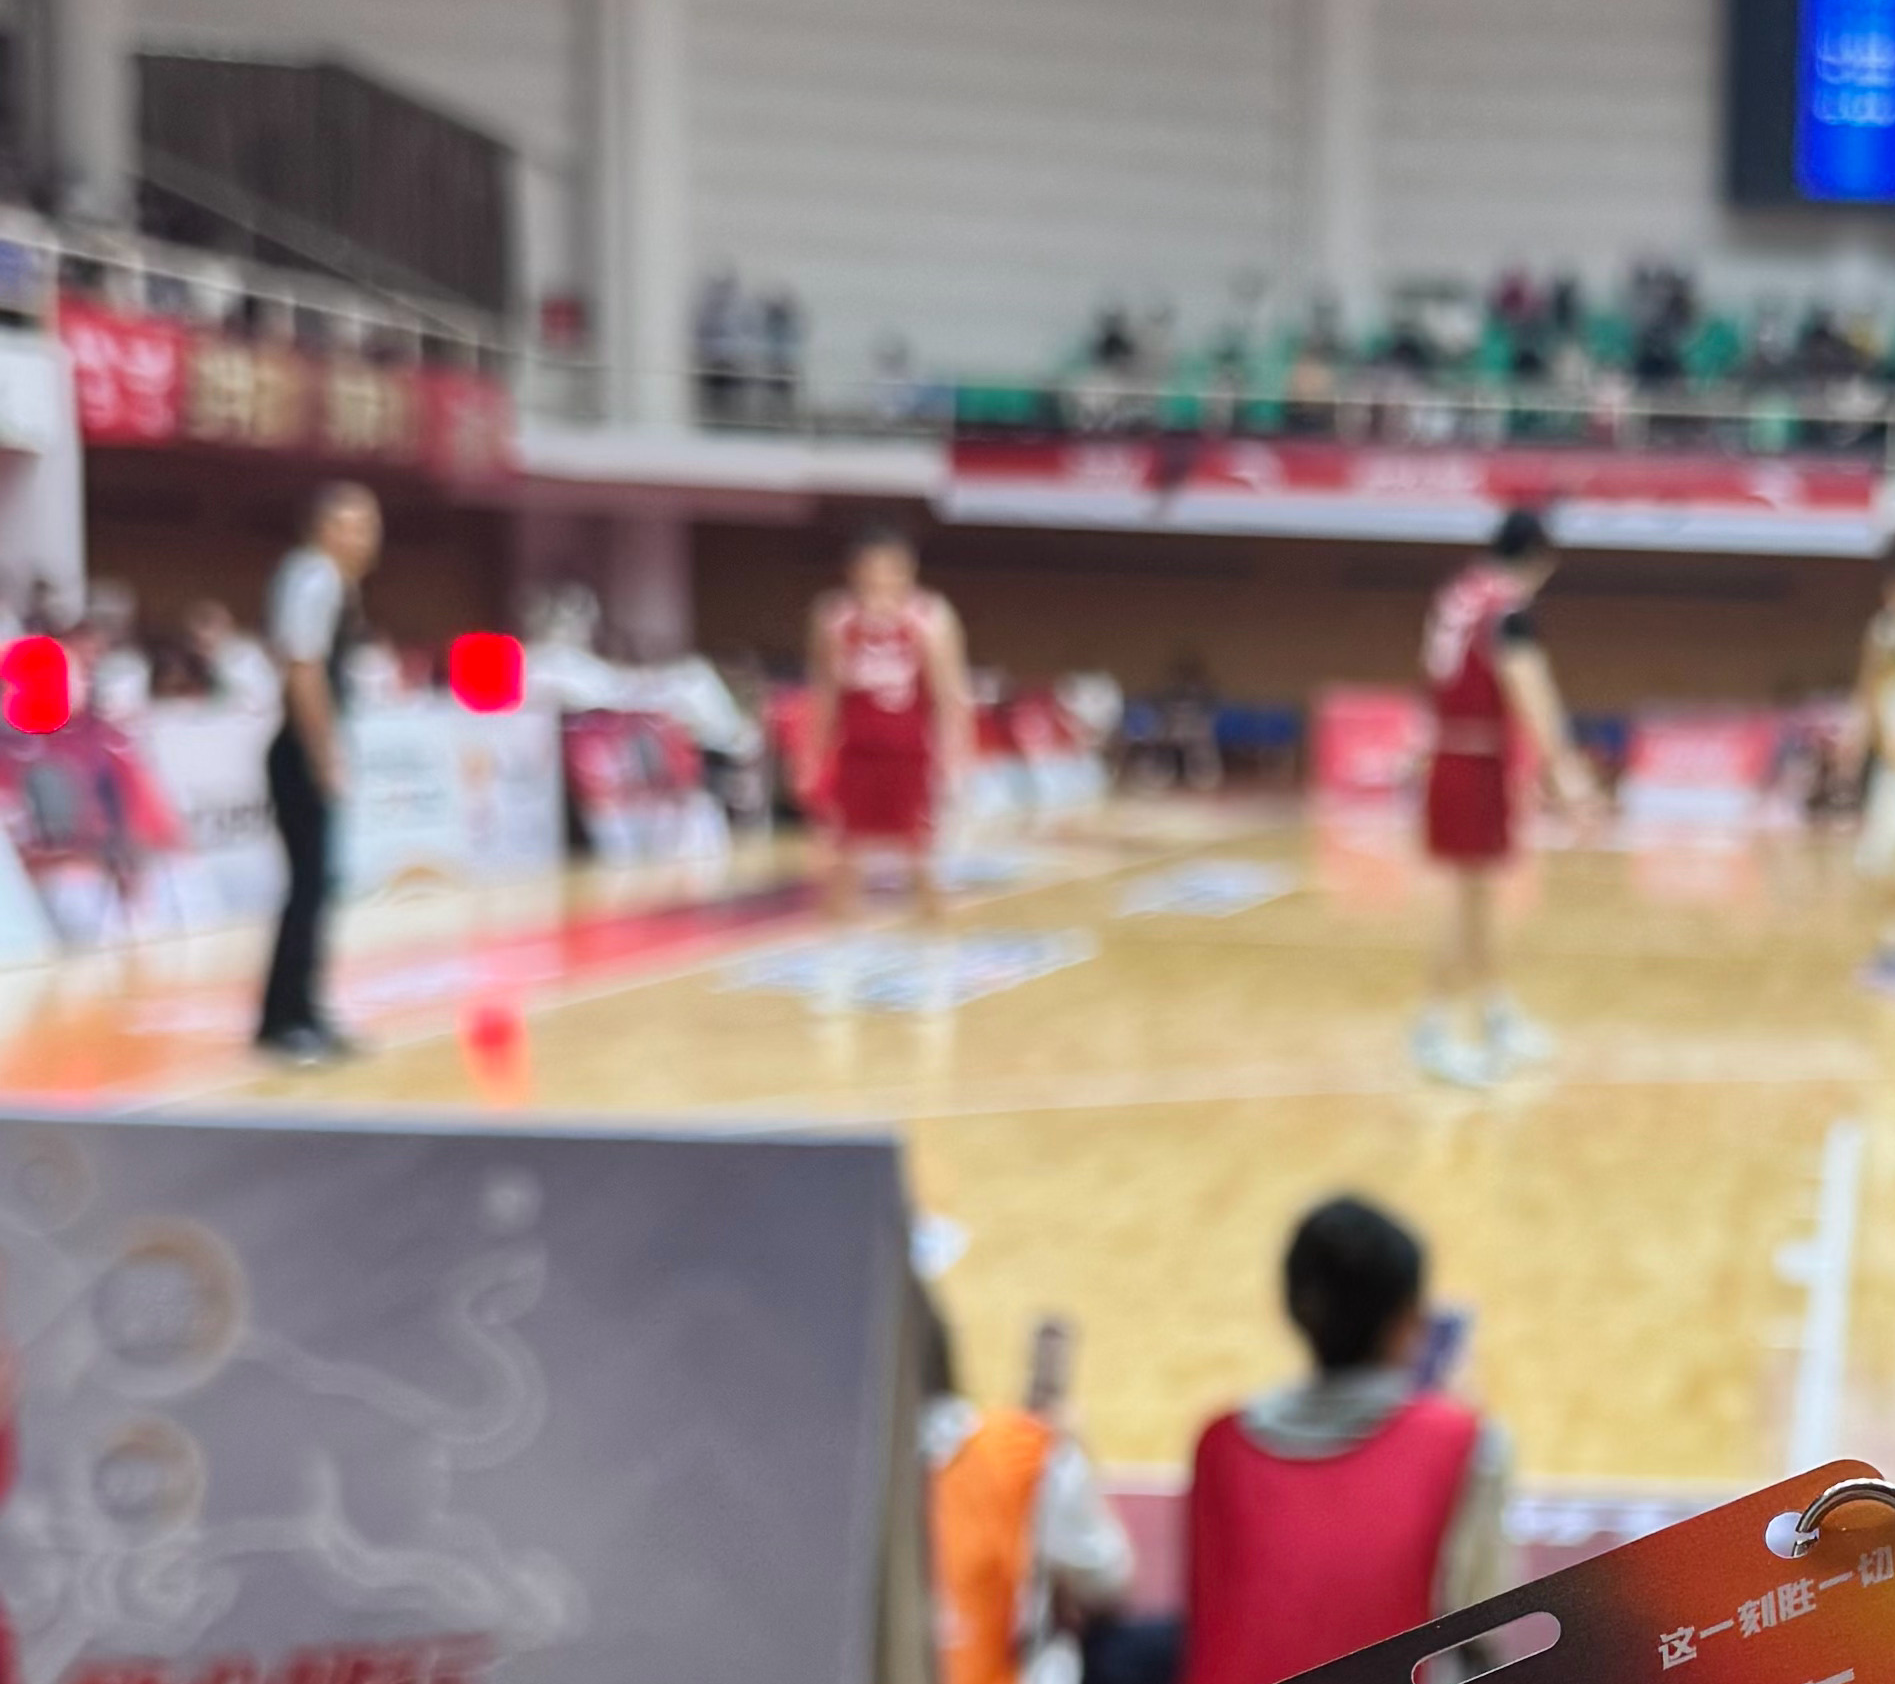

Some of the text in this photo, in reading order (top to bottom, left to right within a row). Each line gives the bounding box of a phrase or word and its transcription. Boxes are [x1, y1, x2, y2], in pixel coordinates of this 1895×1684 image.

[1657, 1545, 1895, 1670] 这一刻胜一切
